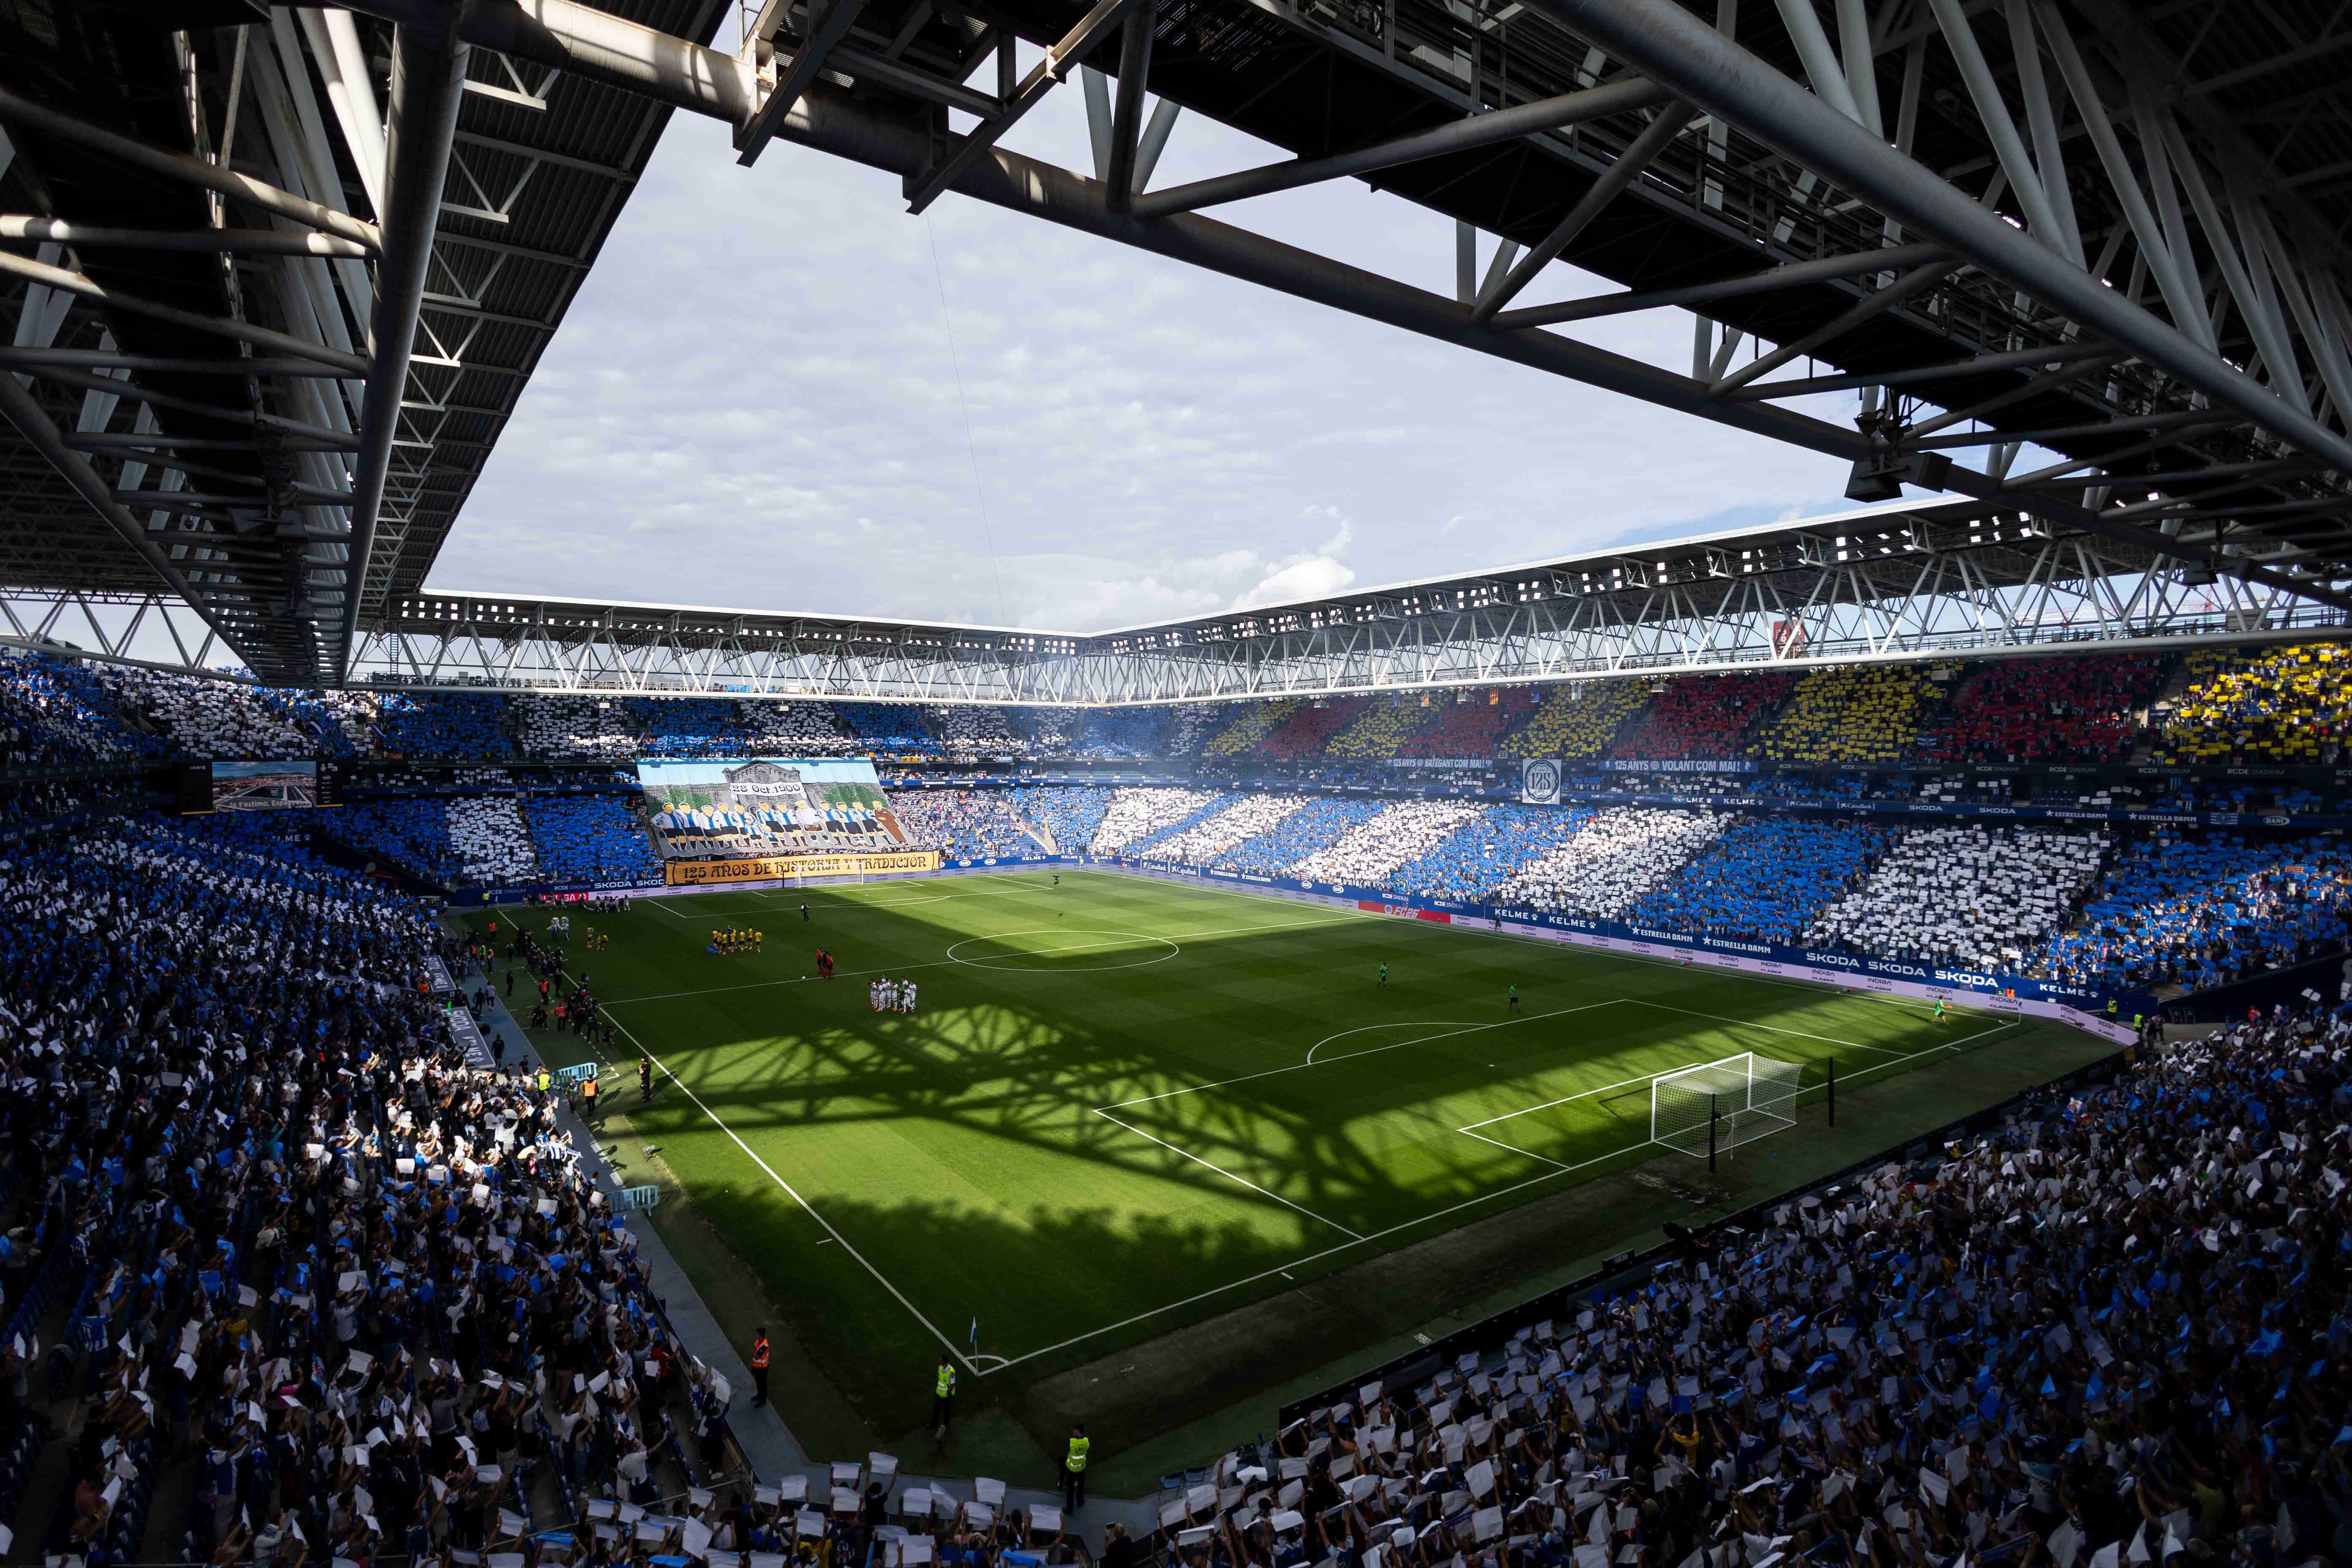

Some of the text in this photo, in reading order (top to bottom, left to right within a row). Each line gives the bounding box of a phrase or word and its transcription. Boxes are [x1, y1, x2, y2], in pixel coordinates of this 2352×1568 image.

[1393, 759, 1402, 767] 125
[1402, 759, 1416, 767] ANYS
[1454, 759, 1468, 768] COM
[1470, 760, 1484, 768] MAI!
[1615, 761, 1741, 772] 125 ANYS VOLANT COM MAI!
[1531, 772, 1551, 790] 125
[683, 866, 707, 879] 125
[711, 863, 749, 877] AÑOS
[754, 863, 772, 875] DE
[843, 859, 853, 870] Y
[856, 855, 926, 870] TRADICIÓN
[1148, 861, 1167, 871] CaixaBank
[1177, 865, 1197, 876] CaixaBank
[595, 880, 632, 889] SKODA
[1446, 902, 1464, 910] STADIUM
[1495, 908, 1529, 920] KELME
[1549, 916, 1586, 928] KELME
[1641, 929, 1693, 943] ESTRELLA DAMM
[1712, 939, 1771, 954] ESTRELLA DAMM
[1806, 952, 1860, 968] SKODA
[1812, 969, 1835, 977] INDIBA
[1868, 960, 1927, 977] SKODA
[1867, 977, 1892, 985] INDIBA
[1935, 970, 1999, 987] SKODA
[1926, 986, 1953, 994] INDIBA
[2040, 985, 2086, 997] KELME
[1989, 995, 2018, 1005] INDIBA
